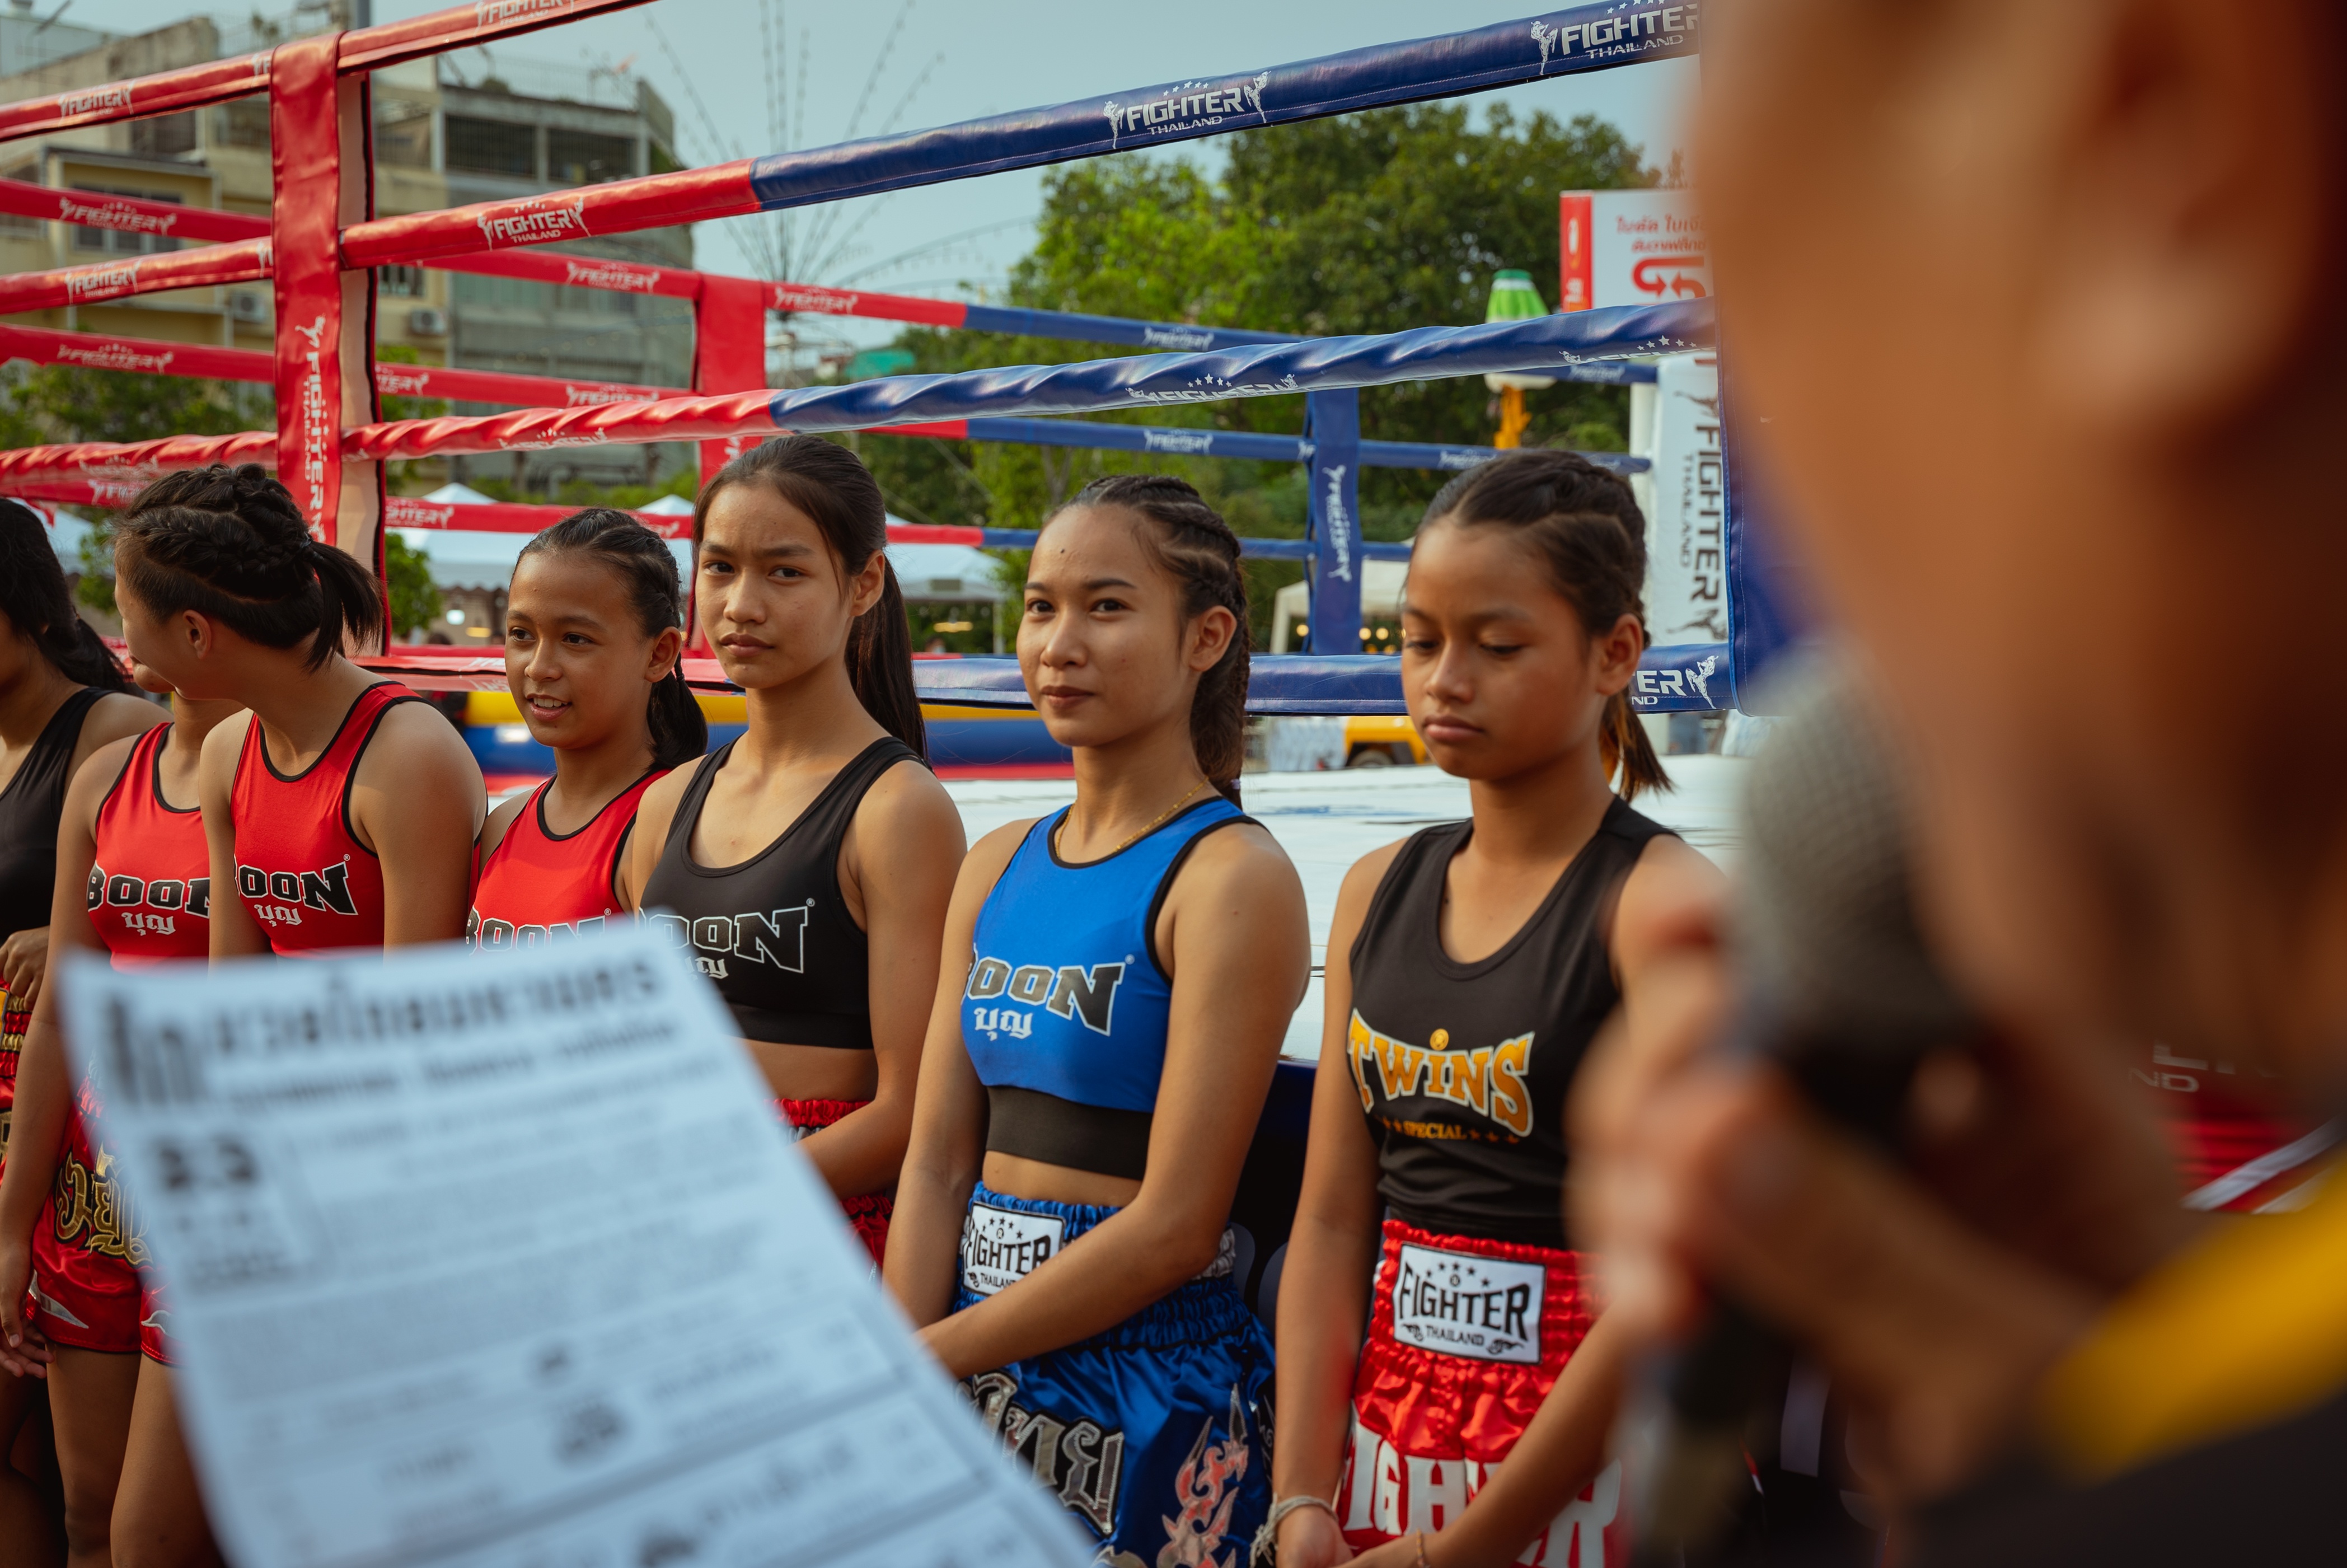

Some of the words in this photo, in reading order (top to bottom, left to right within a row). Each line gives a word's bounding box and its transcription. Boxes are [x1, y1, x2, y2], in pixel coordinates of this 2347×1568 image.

[1585, 35, 1684, 59] THAILAND
[1126, 87, 1245, 132] FIGHTER
[1147, 116, 1222, 135] THAILAND
[493, 209, 574, 240] FIGHTER
[510, 230, 561, 243] THAILAND
[75, 266, 129, 294] FIGHTER
[307, 351, 324, 511] FIGHTER
[1690, 424, 1722, 602] FIGHTER
[233, 854, 358, 915] OON
[121, 912, 176, 936] บุญ
[254, 904, 302, 927] บุญ
[638, 906, 808, 973] OON
[961, 943, 1126, 1036] OON
[974, 1007, 1033, 1041] บุญ
[1347, 1007, 1535, 1138] TWINS
[1403, 1120, 1468, 1140] SPECIAL
[1399, 1261, 1530, 1342] FIGHTER
[1426, 1325, 1485, 1346] THAILAND
